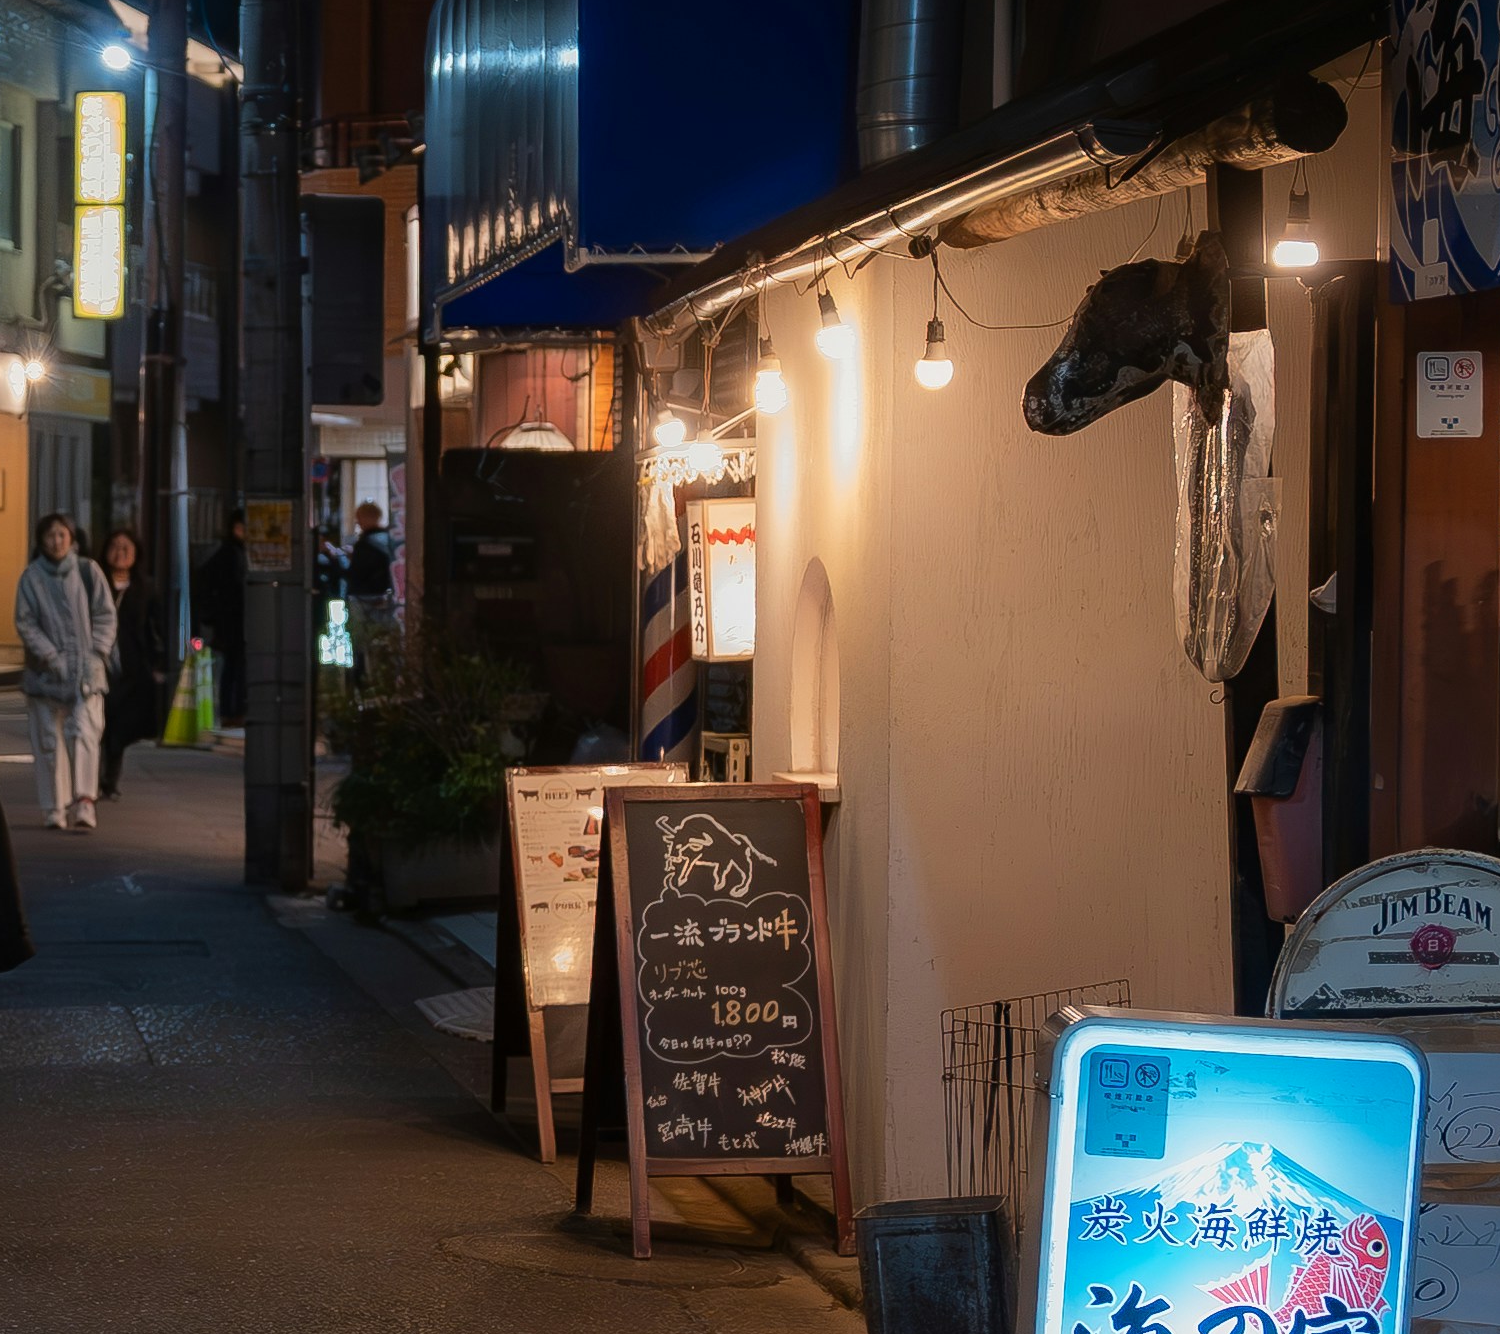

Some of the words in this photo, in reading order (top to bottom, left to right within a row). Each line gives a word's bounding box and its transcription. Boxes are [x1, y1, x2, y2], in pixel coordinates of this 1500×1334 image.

[1373, 893, 1419, 935] JIM
[1424, 887, 1493, 934] BEAM
[715, 984, 748, 998] 100g
[1078, 1196, 1343, 1259] 炭火海鮮焼
